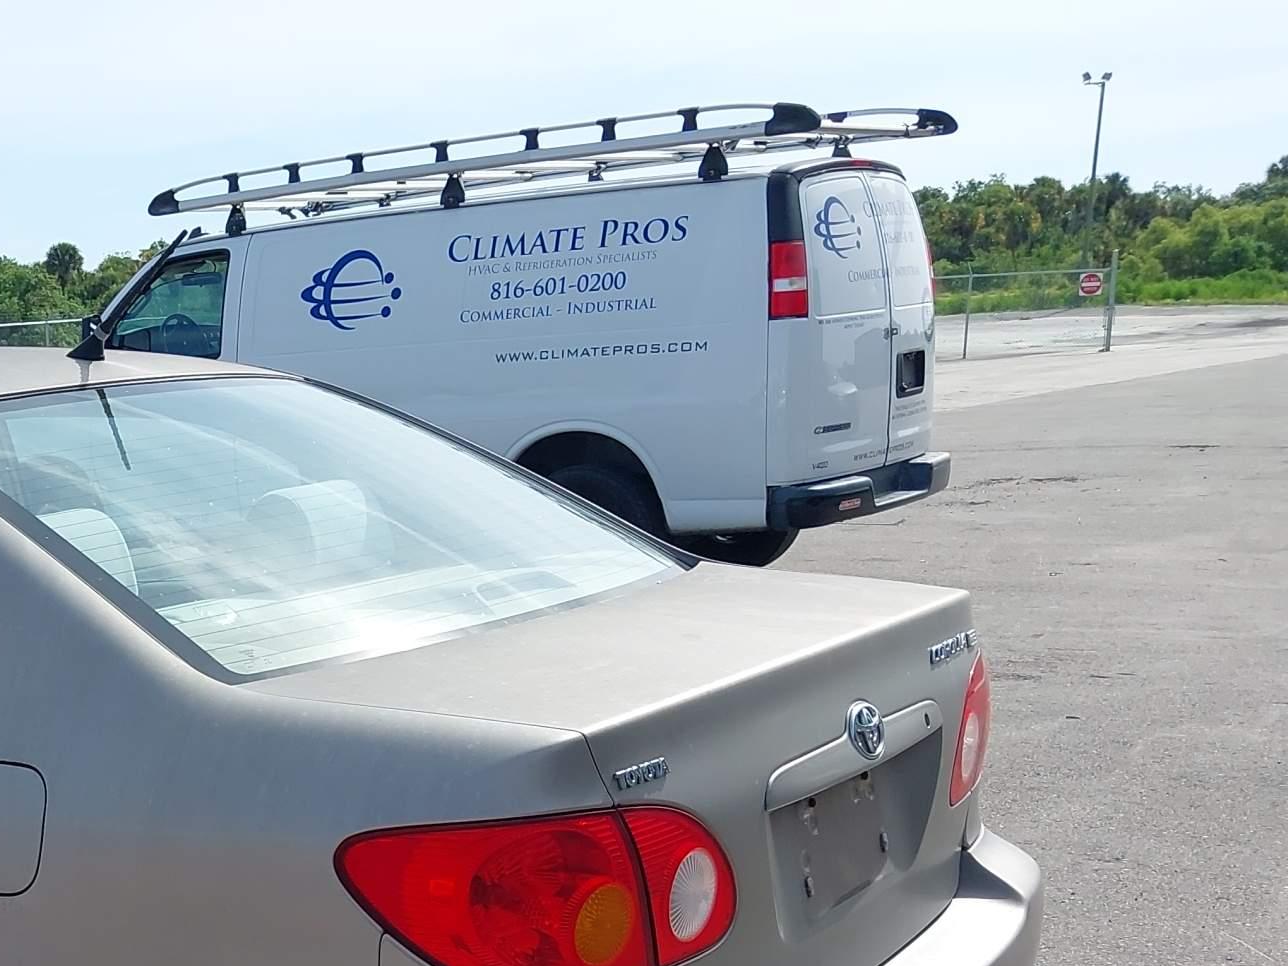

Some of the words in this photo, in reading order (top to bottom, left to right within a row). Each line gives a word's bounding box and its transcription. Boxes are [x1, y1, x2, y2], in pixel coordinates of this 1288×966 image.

[447, 225, 587, 264] CLIMATE
[599, 215, 689, 249] PROS
[468, 263, 500, 276] HVAC
[503, 263, 511, 272] &
[515, 257, 593, 272] REFRIGERATION
[596, 250, 657, 265] SPECIALISTS
[489, 271, 627, 301] 816-601-0200
[459, 304, 553, 324] COMMERCIAL
[567, 297, 657, 316] INDUSTRIAL
[495, 340, 709, 364] WWW.CLIMATEPROS.COM
[613, 757, 671, 790] TOYOTA
